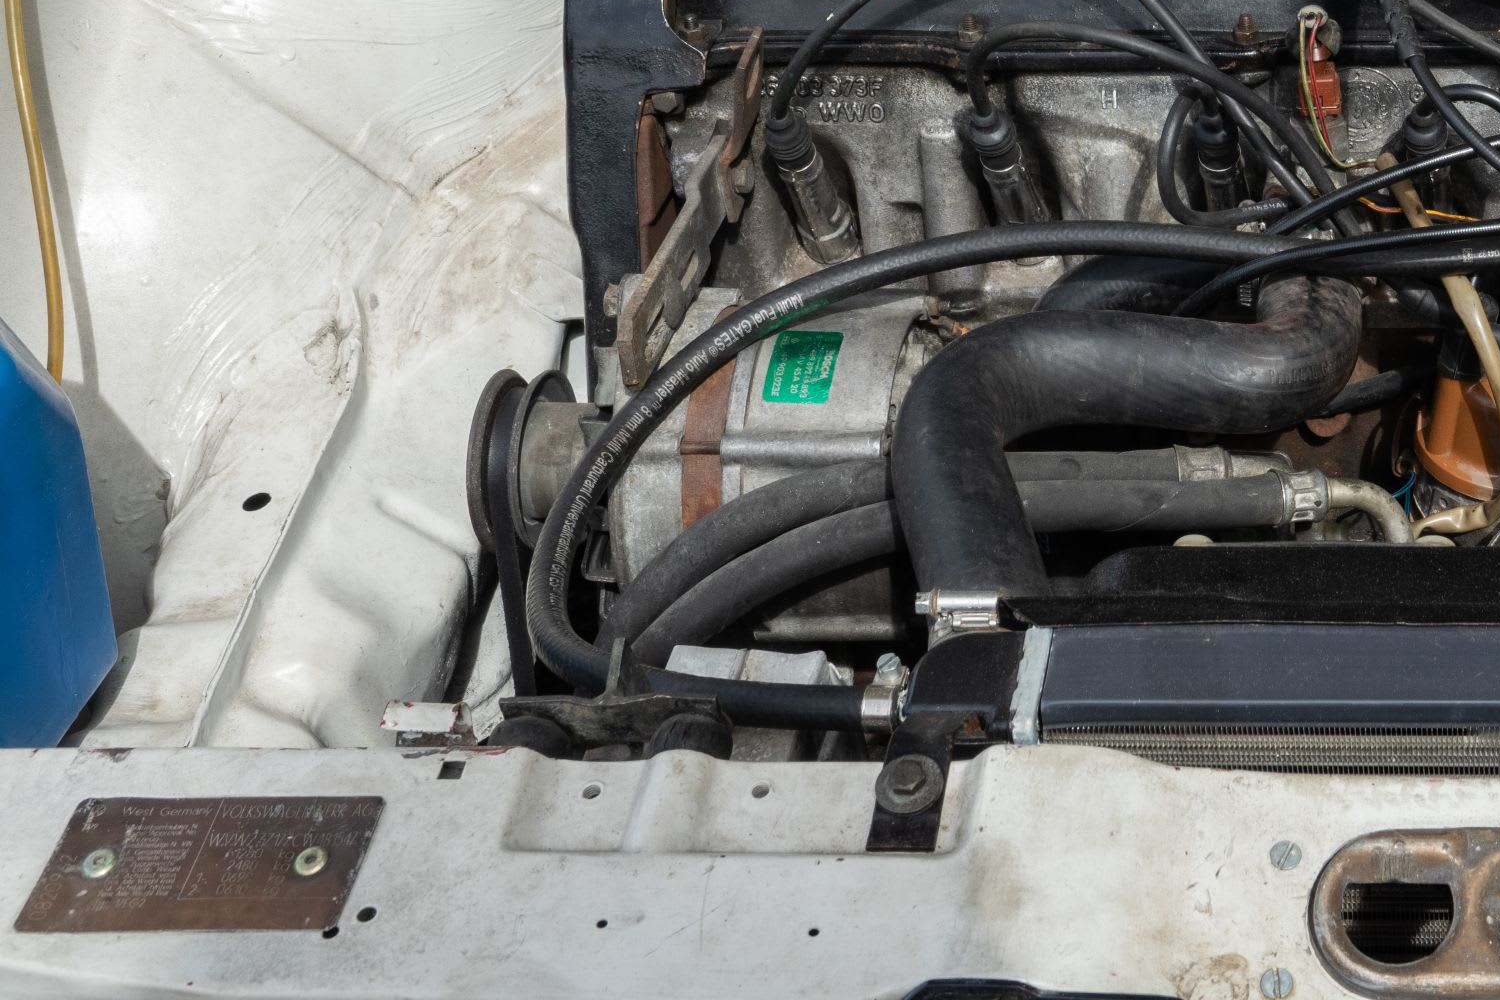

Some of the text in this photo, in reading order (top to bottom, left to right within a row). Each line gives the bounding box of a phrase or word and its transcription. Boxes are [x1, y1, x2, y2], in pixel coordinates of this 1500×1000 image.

[828, 75, 884, 97] 373F
[753, 305, 779, 328] Fuel
[775, 293, 804, 317] Multi
[684, 347, 711, 374] Auto
[639, 404, 653, 417] 8
[625, 412, 647, 435] mm
[605, 425, 634, 455] Multi
[578, 451, 616, 495] Carburant
[122, 805, 213, 818] West Germany
[273, 860, 291, 873] kg
[278, 849, 296, 861] kg
